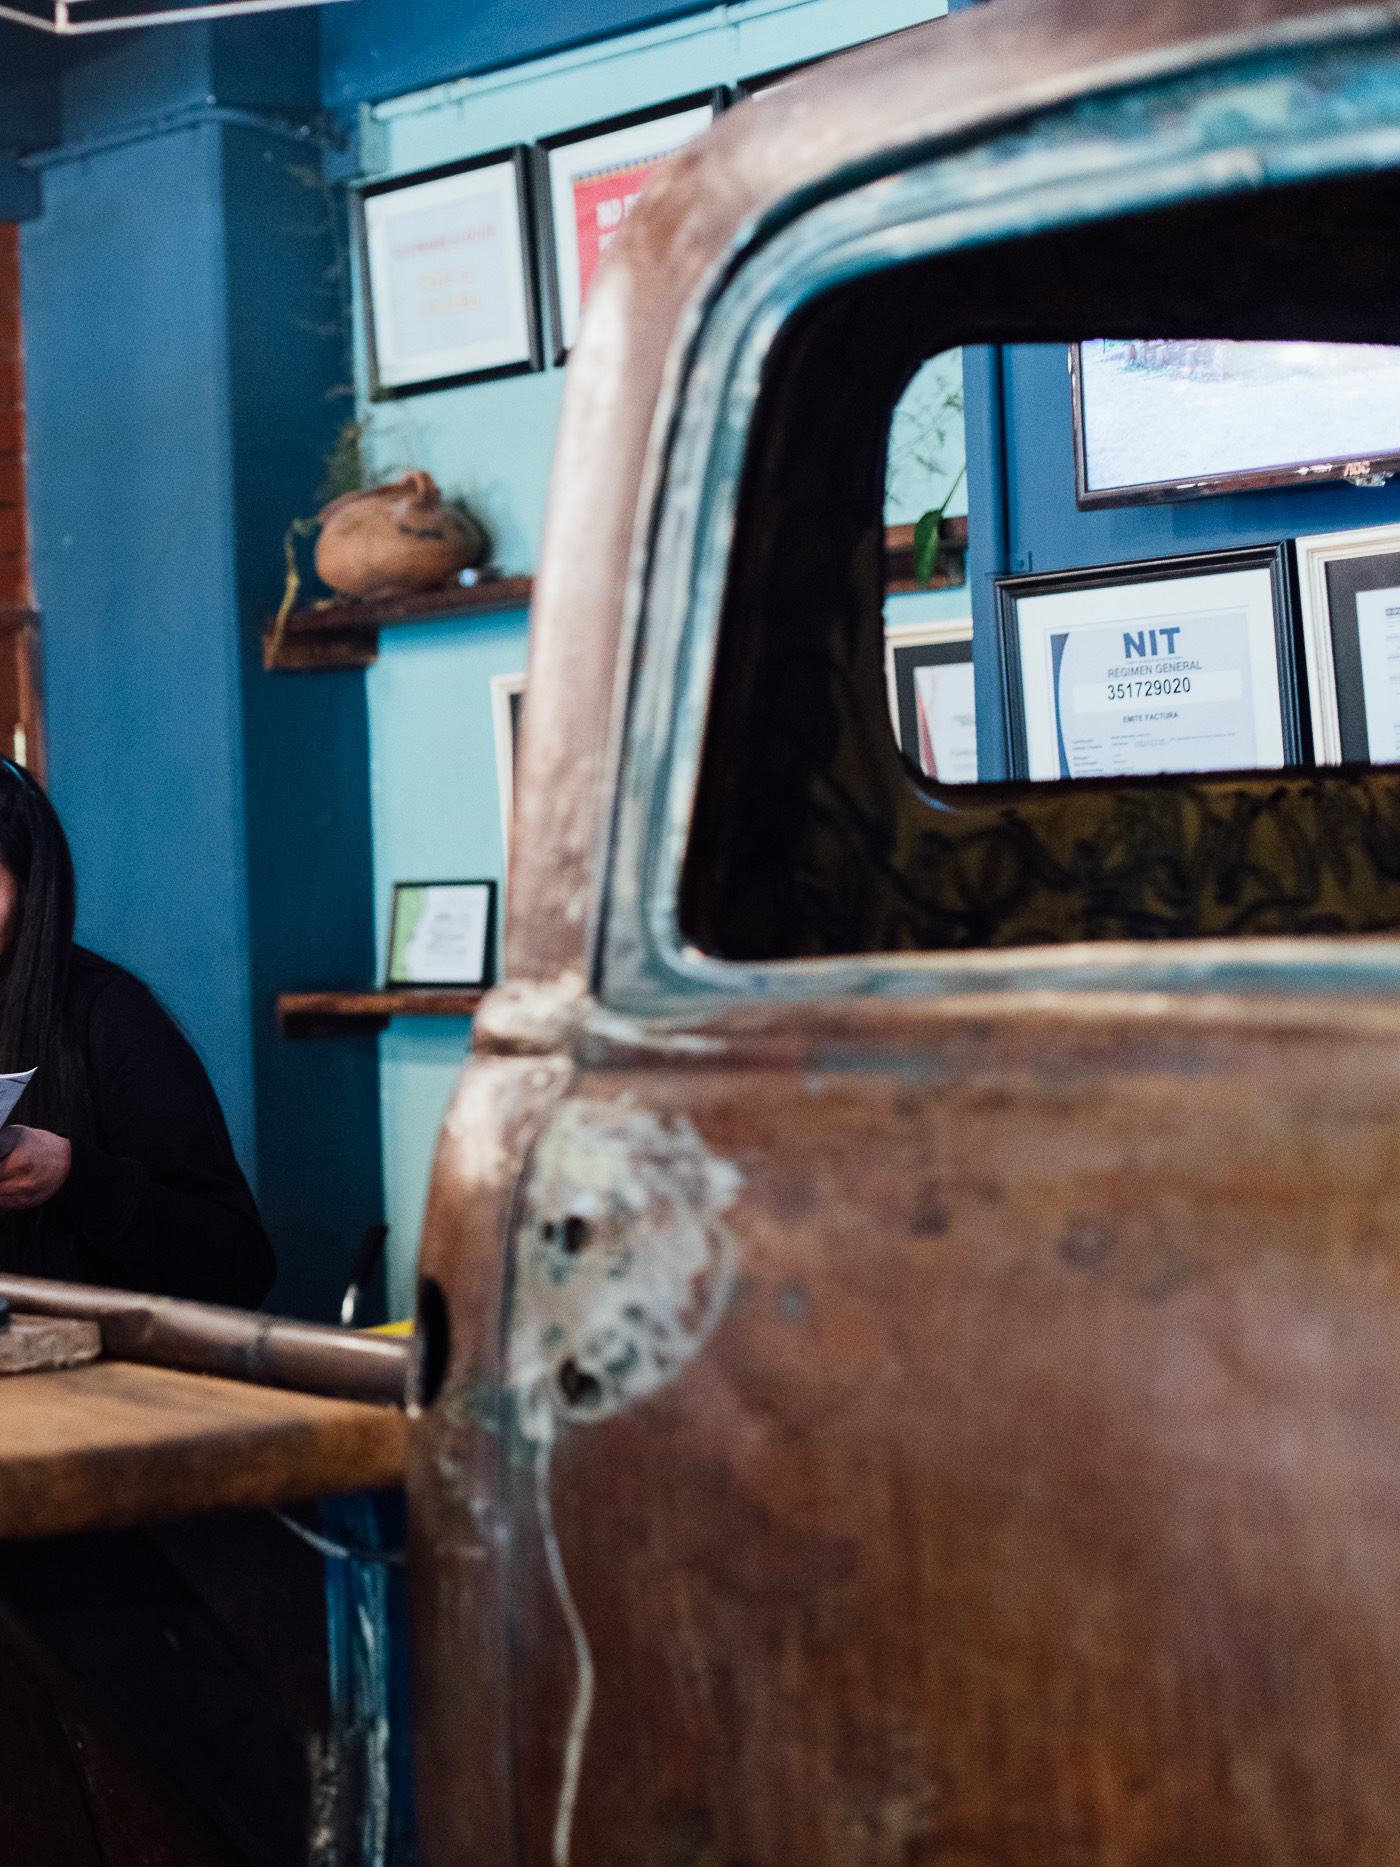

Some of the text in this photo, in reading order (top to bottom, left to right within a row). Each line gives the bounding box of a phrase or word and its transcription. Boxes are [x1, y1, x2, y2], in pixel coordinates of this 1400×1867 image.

[1123, 627, 1181, 658] NIT
[1155, 660, 1203, 674] GENERAL
[1107, 677, 1191, 700] 351729020
